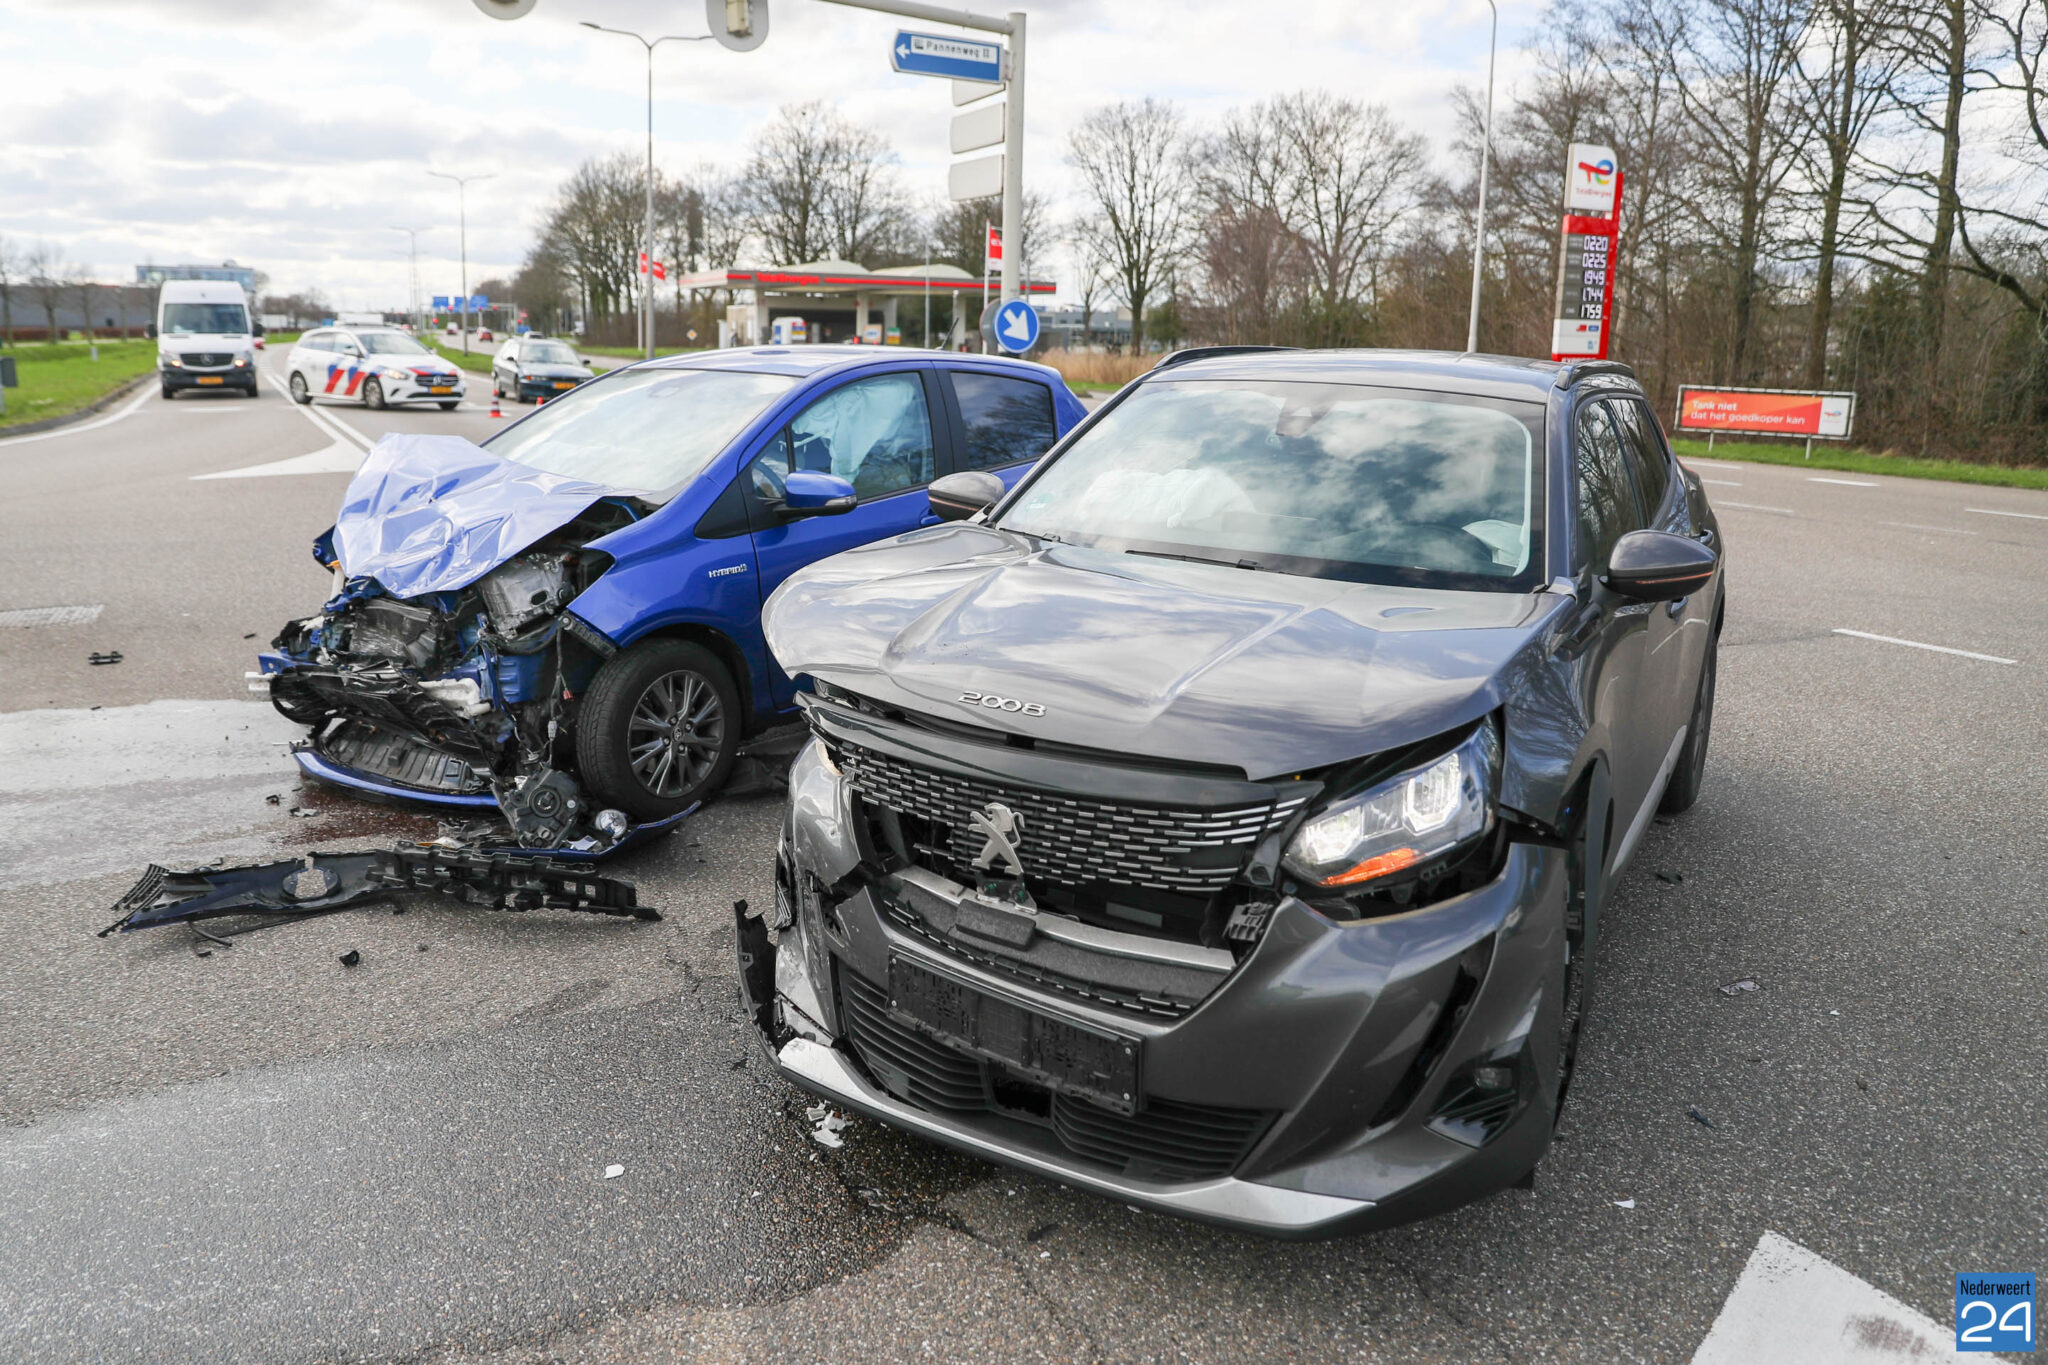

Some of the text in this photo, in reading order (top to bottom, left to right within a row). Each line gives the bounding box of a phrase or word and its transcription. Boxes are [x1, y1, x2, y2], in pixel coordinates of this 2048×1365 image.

[926, 41, 980, 58] Pannenweg
[1693, 400, 1737, 411] Tank niet
[1690, 411, 1806, 425] dat het goedkoper kan
[708, 565, 741, 579] HYBRID
[957, 690, 1047, 717] 2008
